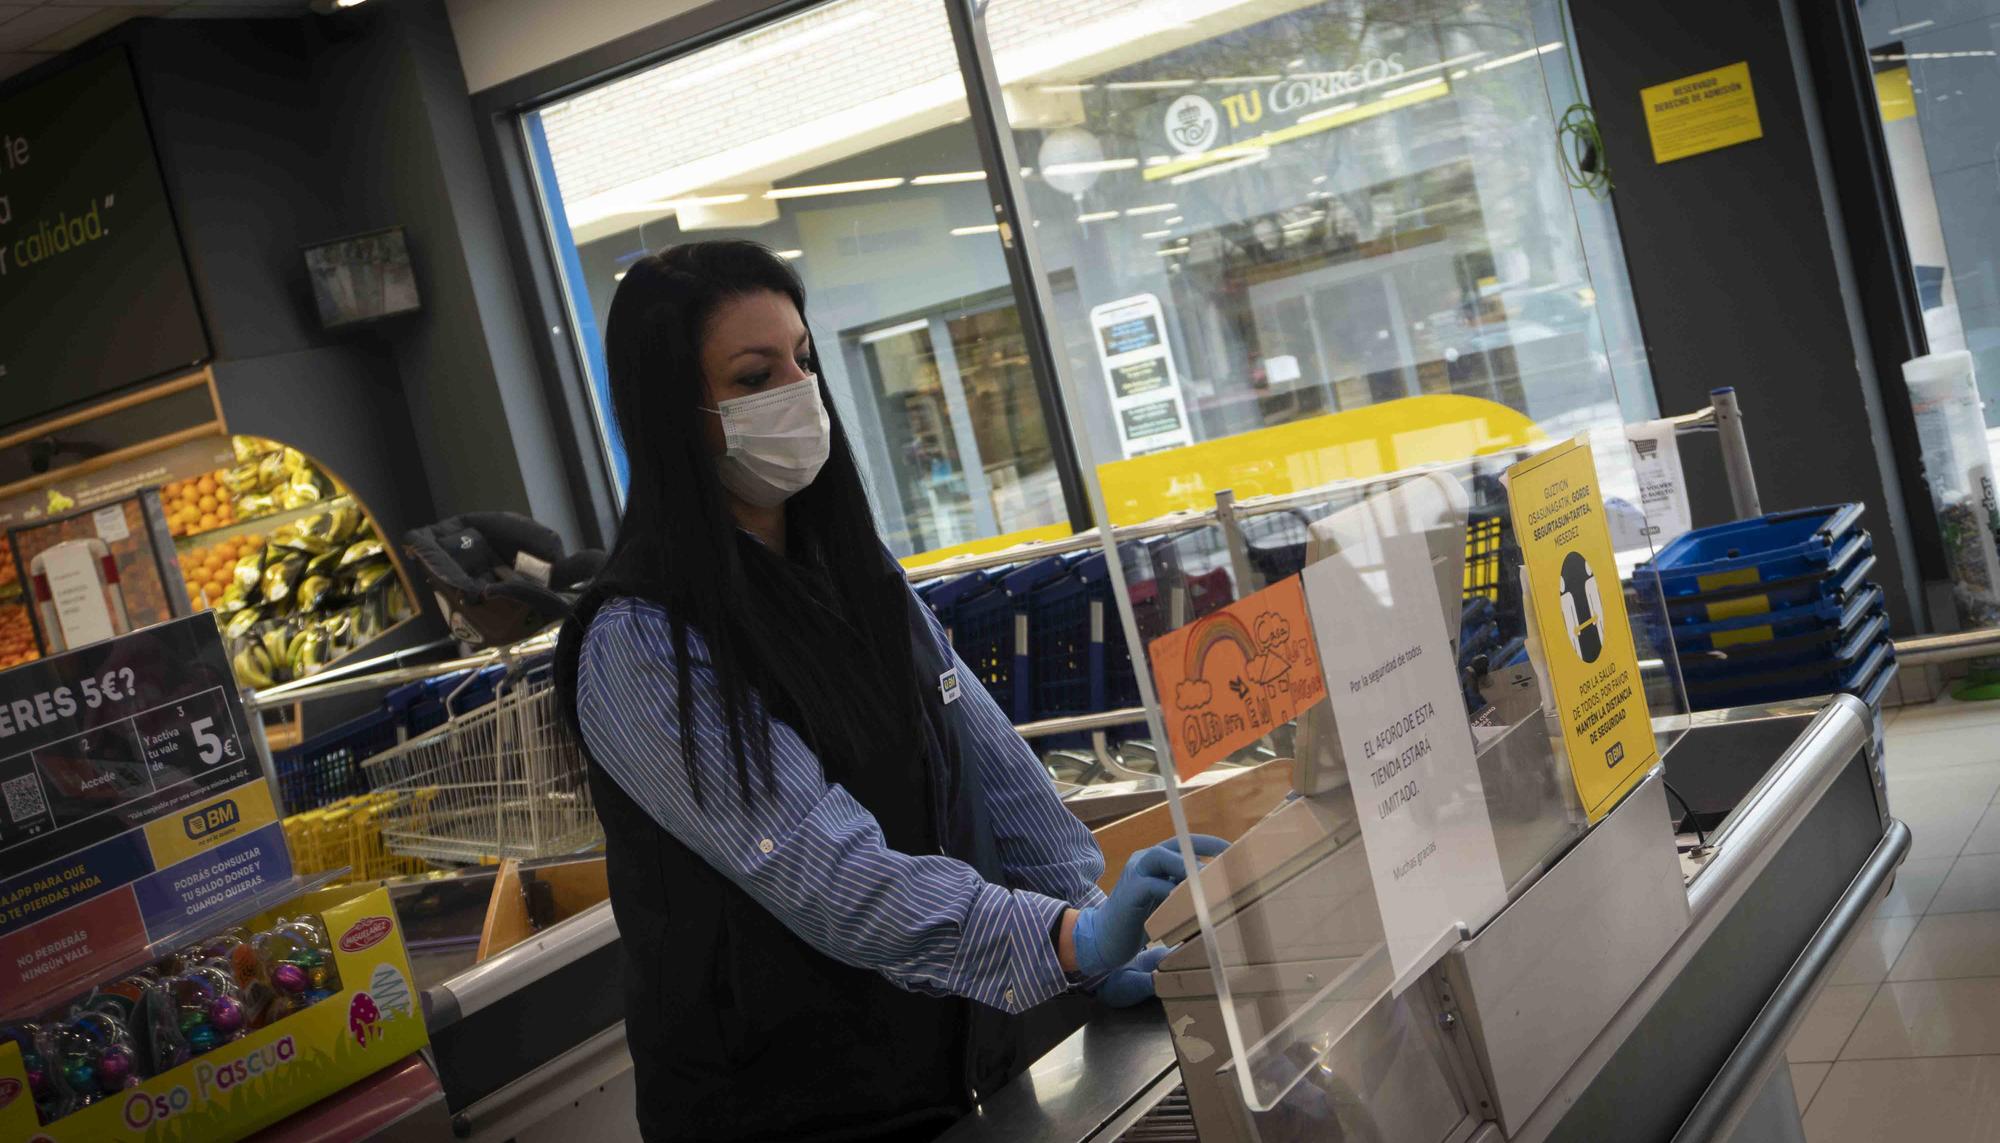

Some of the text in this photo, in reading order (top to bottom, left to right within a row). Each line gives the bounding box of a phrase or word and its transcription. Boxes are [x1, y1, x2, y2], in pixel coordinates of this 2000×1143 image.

[1221, 52, 1404, 128] TU CORREOS
[5, 134, 30, 168] te
[80, 667, 136, 710] 5€?
[1350, 645, 1423, 694] Por la seguridad de todos
[1579, 662, 1616, 697] POR LA SALUD
[177, 706, 185, 718] 3
[1573, 706, 1581, 722] DE
[1601, 683, 1613, 699] POR
[1611, 670, 1630, 691] FAVOR
[1598, 704, 1607, 720] LA
[1605, 686, 1633, 714] DISTANCIA
[81, 740, 91, 752] 2
[151, 727, 181, 745] activa
[1364, 702, 1435, 759] EL AFORO DE ESTA
[1590, 708, 1627, 745] DE SEGURIDAD
[147, 741, 180, 760] tu vale
[1371, 733, 1432, 789] TIENDA ESTARÁ
[80, 771, 117, 793] Accede
[1378, 780, 1420, 820] LIMITADO.
[207, 804, 235, 829] BM
[174, 847, 261, 892] PODRÁS CONSULTAR
[1393, 841, 1437, 880] Muchas gracias
[7, 905, 24, 921] TE
[23, 887, 71, 916] PIERDAS
[71, 874, 103, 896] NADA
[10, 885, 32, 904] APP
[33, 874, 62, 894] PARA
[63, 863, 87, 882] QUE
[181, 860, 262, 904] TU SALDO DONDE Y
[186, 877, 265, 916] CUANDO QUIERAS.
[16, 929, 88, 968] NO PERDERÁS
[20, 955, 64, 984] NINGÚN
[124, 1033, 296, 1131] Oso Pascua
